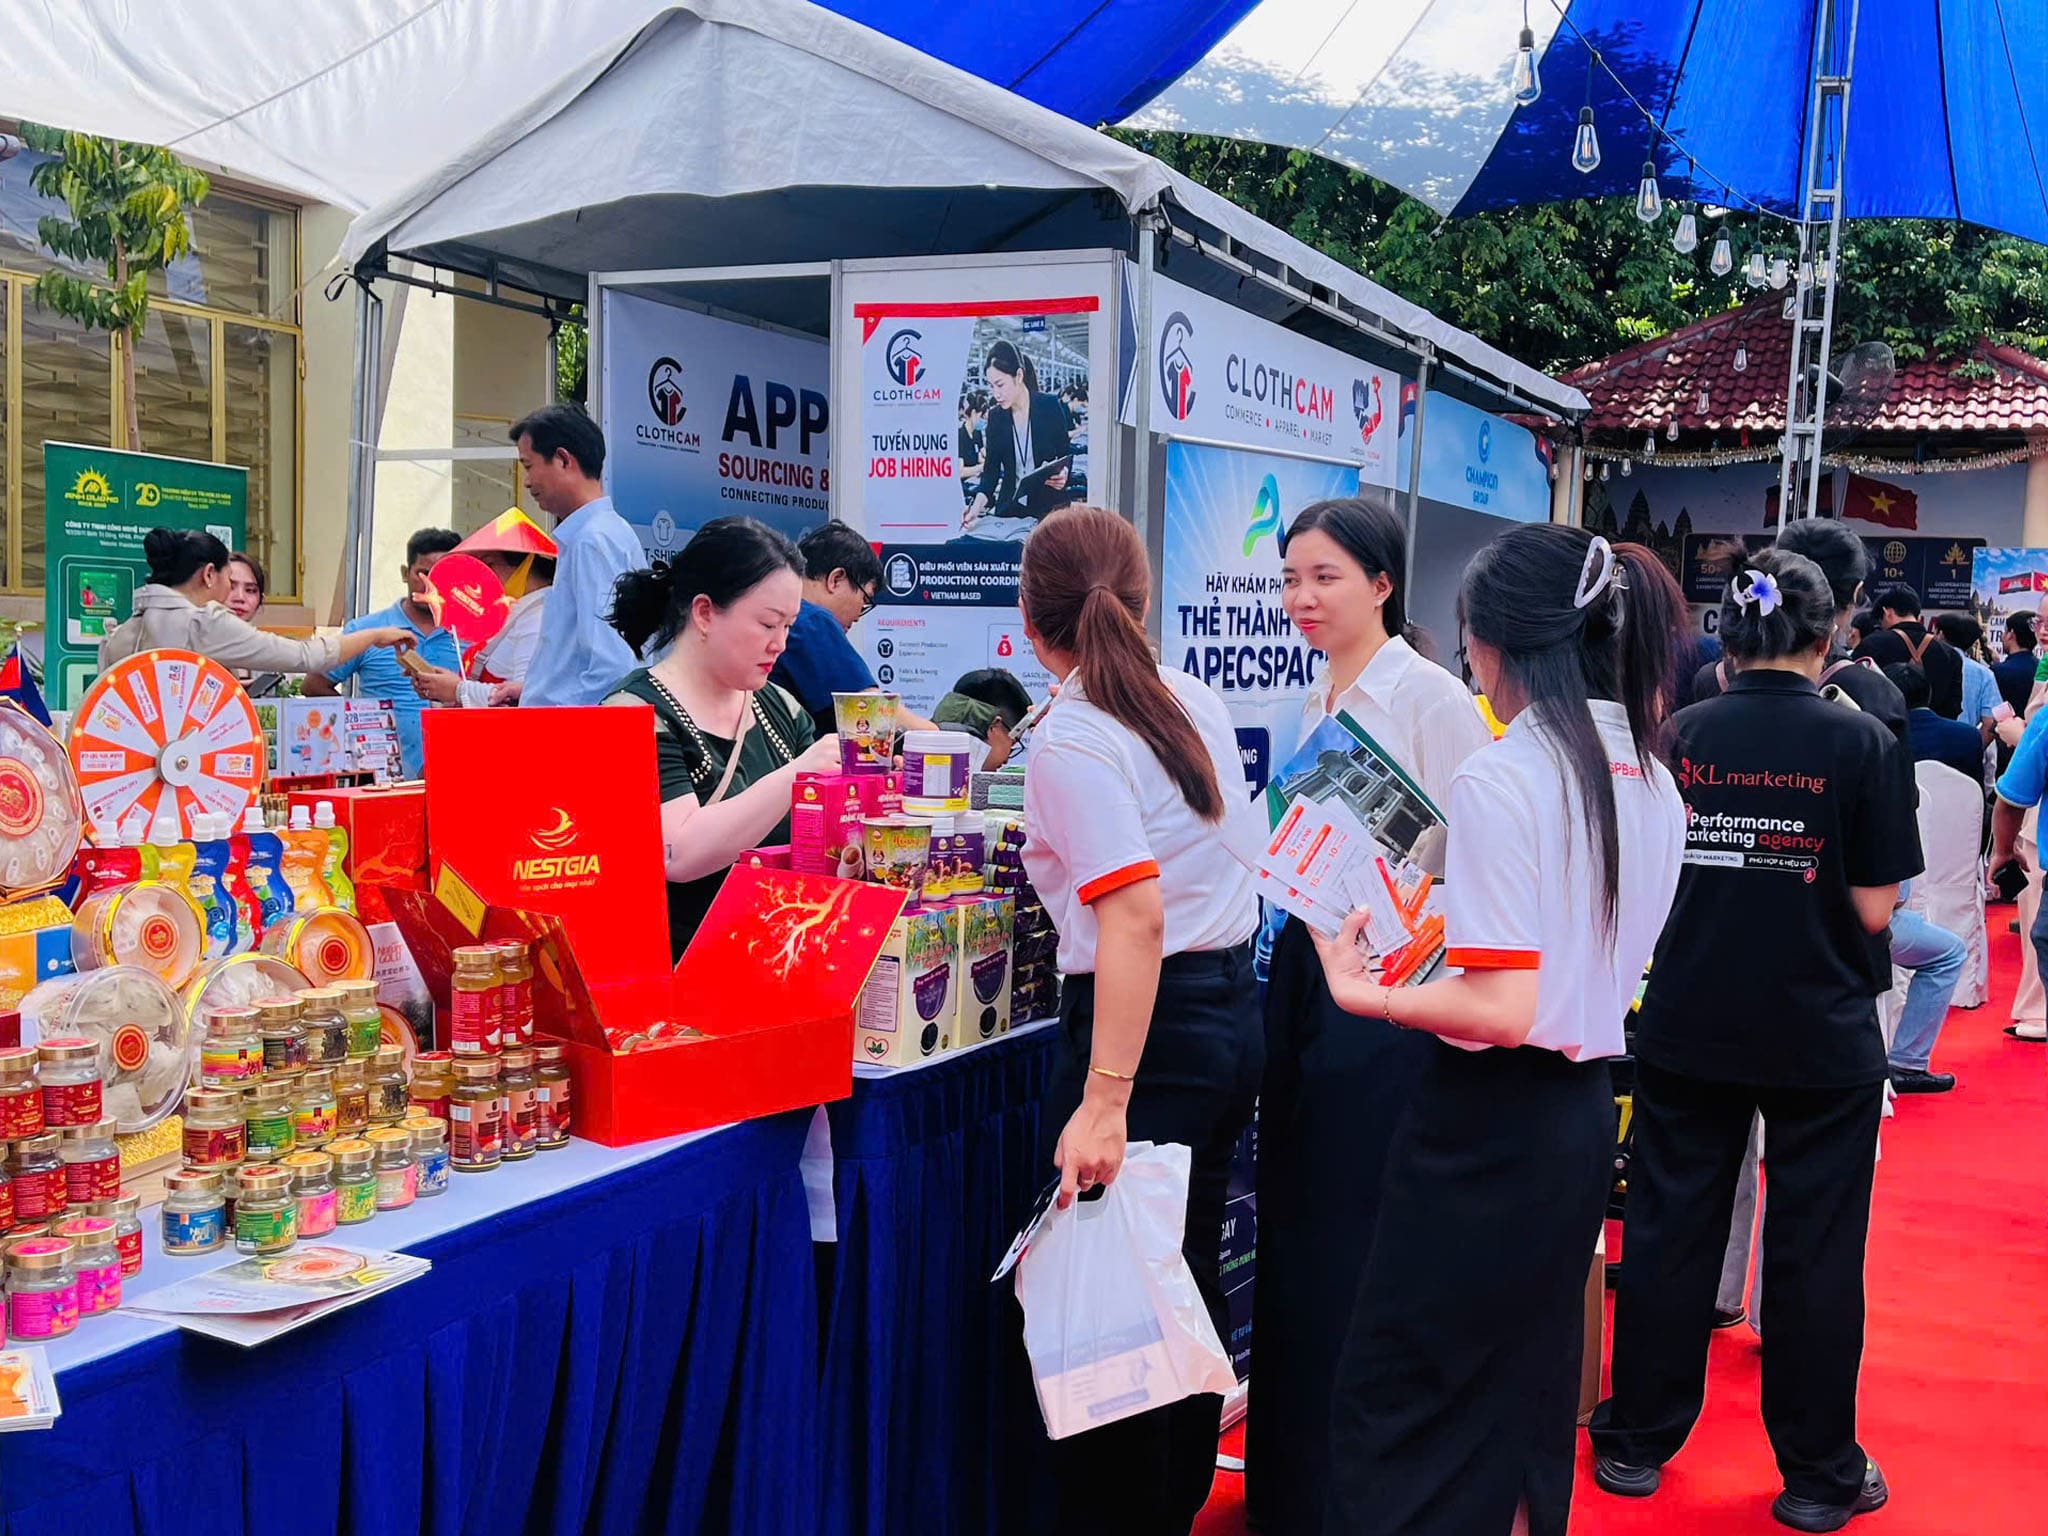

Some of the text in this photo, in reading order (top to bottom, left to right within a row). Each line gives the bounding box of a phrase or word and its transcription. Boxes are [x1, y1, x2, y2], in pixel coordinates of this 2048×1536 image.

[873, 389, 941, 401] CLOTHCAM
[1226, 354, 1334, 424] CLOTHCAM
[721, 374, 829, 459] APP
[1225, 403, 1333, 446] COMMERCE APPAREL MARKET
[636, 424, 700, 447] CLOTHCAM
[913, 433, 948, 454] DỤNG
[718, 452, 829, 492] SOURCING &
[868, 457, 952, 478] JOB HIRING
[720, 486, 788, 506] CONNECTING
[920, 575, 978, 585] PRODUCTION
[1206, 571, 1229, 592] HÃY
[1232, 573, 1266, 593] KHÁM
[1883, 567, 1904, 578] 10+
[1951, 568, 1957, 579] 1
[931, 591, 981, 600] VIETNAM BASED
[1178, 597, 1291, 636] THẺ THÀNH
[1183, 646, 1329, 690] APECSPAC
[1727, 770, 1827, 794] marketing
[1690, 812, 1805, 833] Performance
[1686, 828, 1826, 852] arketing agency
[512, 854, 600, 881] NESTGIA
[1703, 854, 1738, 863] MARKETING
